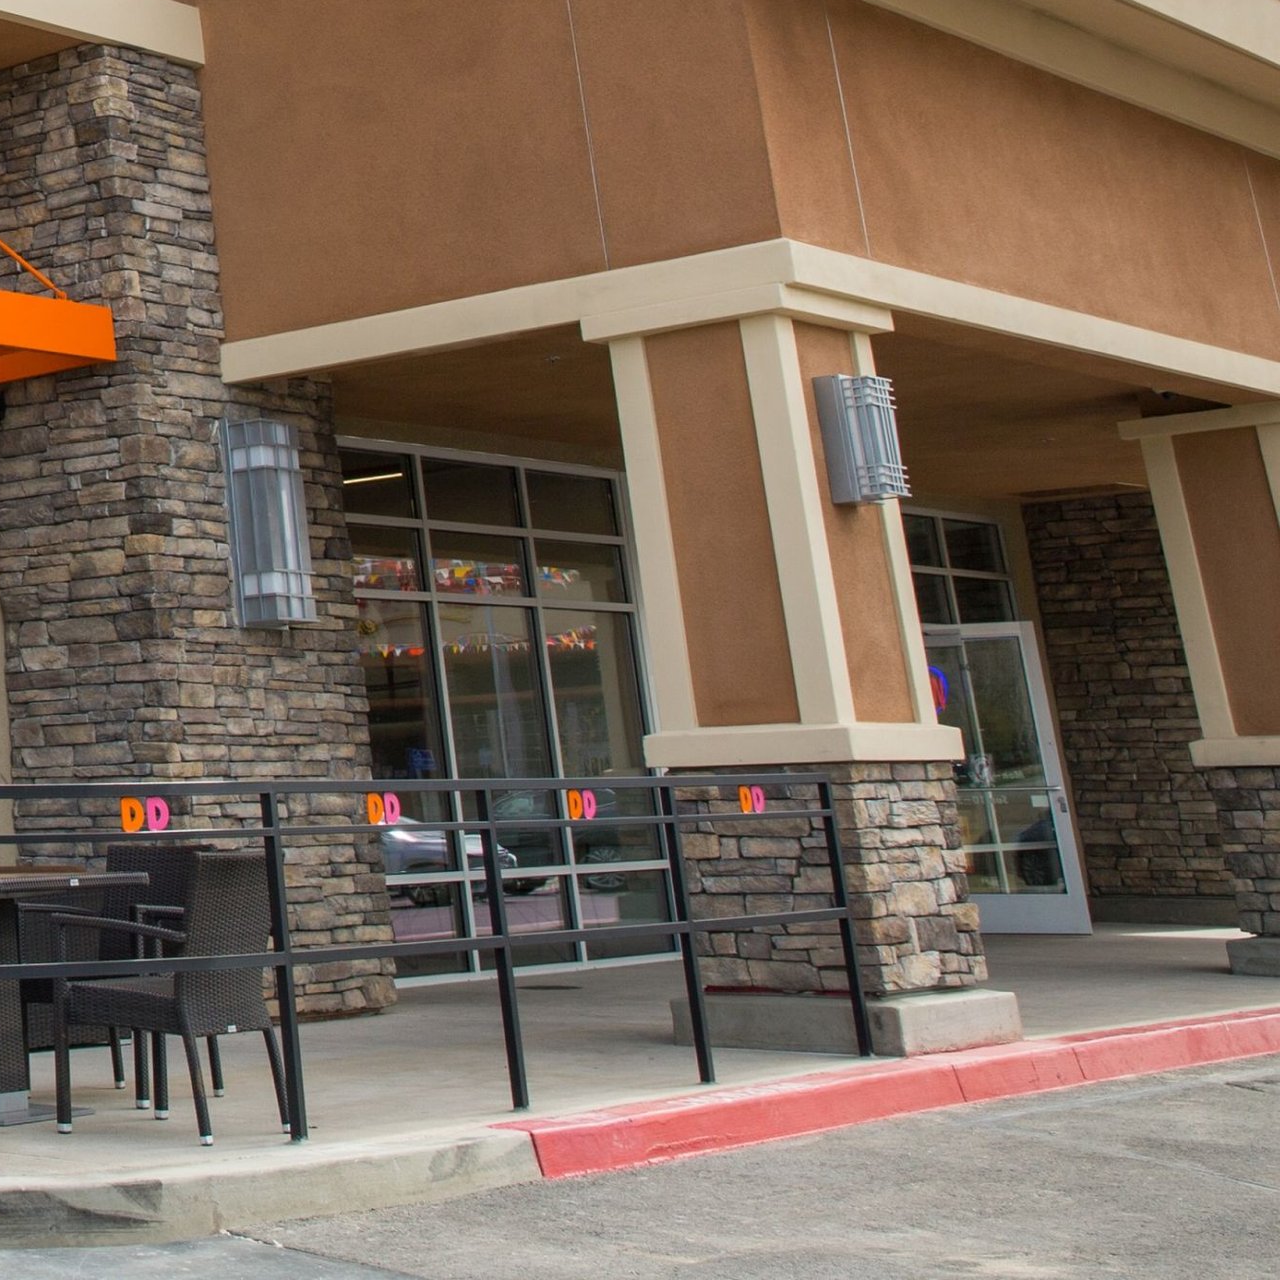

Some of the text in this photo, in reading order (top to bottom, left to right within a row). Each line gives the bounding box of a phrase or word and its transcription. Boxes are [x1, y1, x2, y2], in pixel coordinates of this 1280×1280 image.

[121, 797, 169, 831] DD
[367, 792, 400, 824] DD
[568, 789, 597, 820] DD
[739, 785, 765, 813] DD
